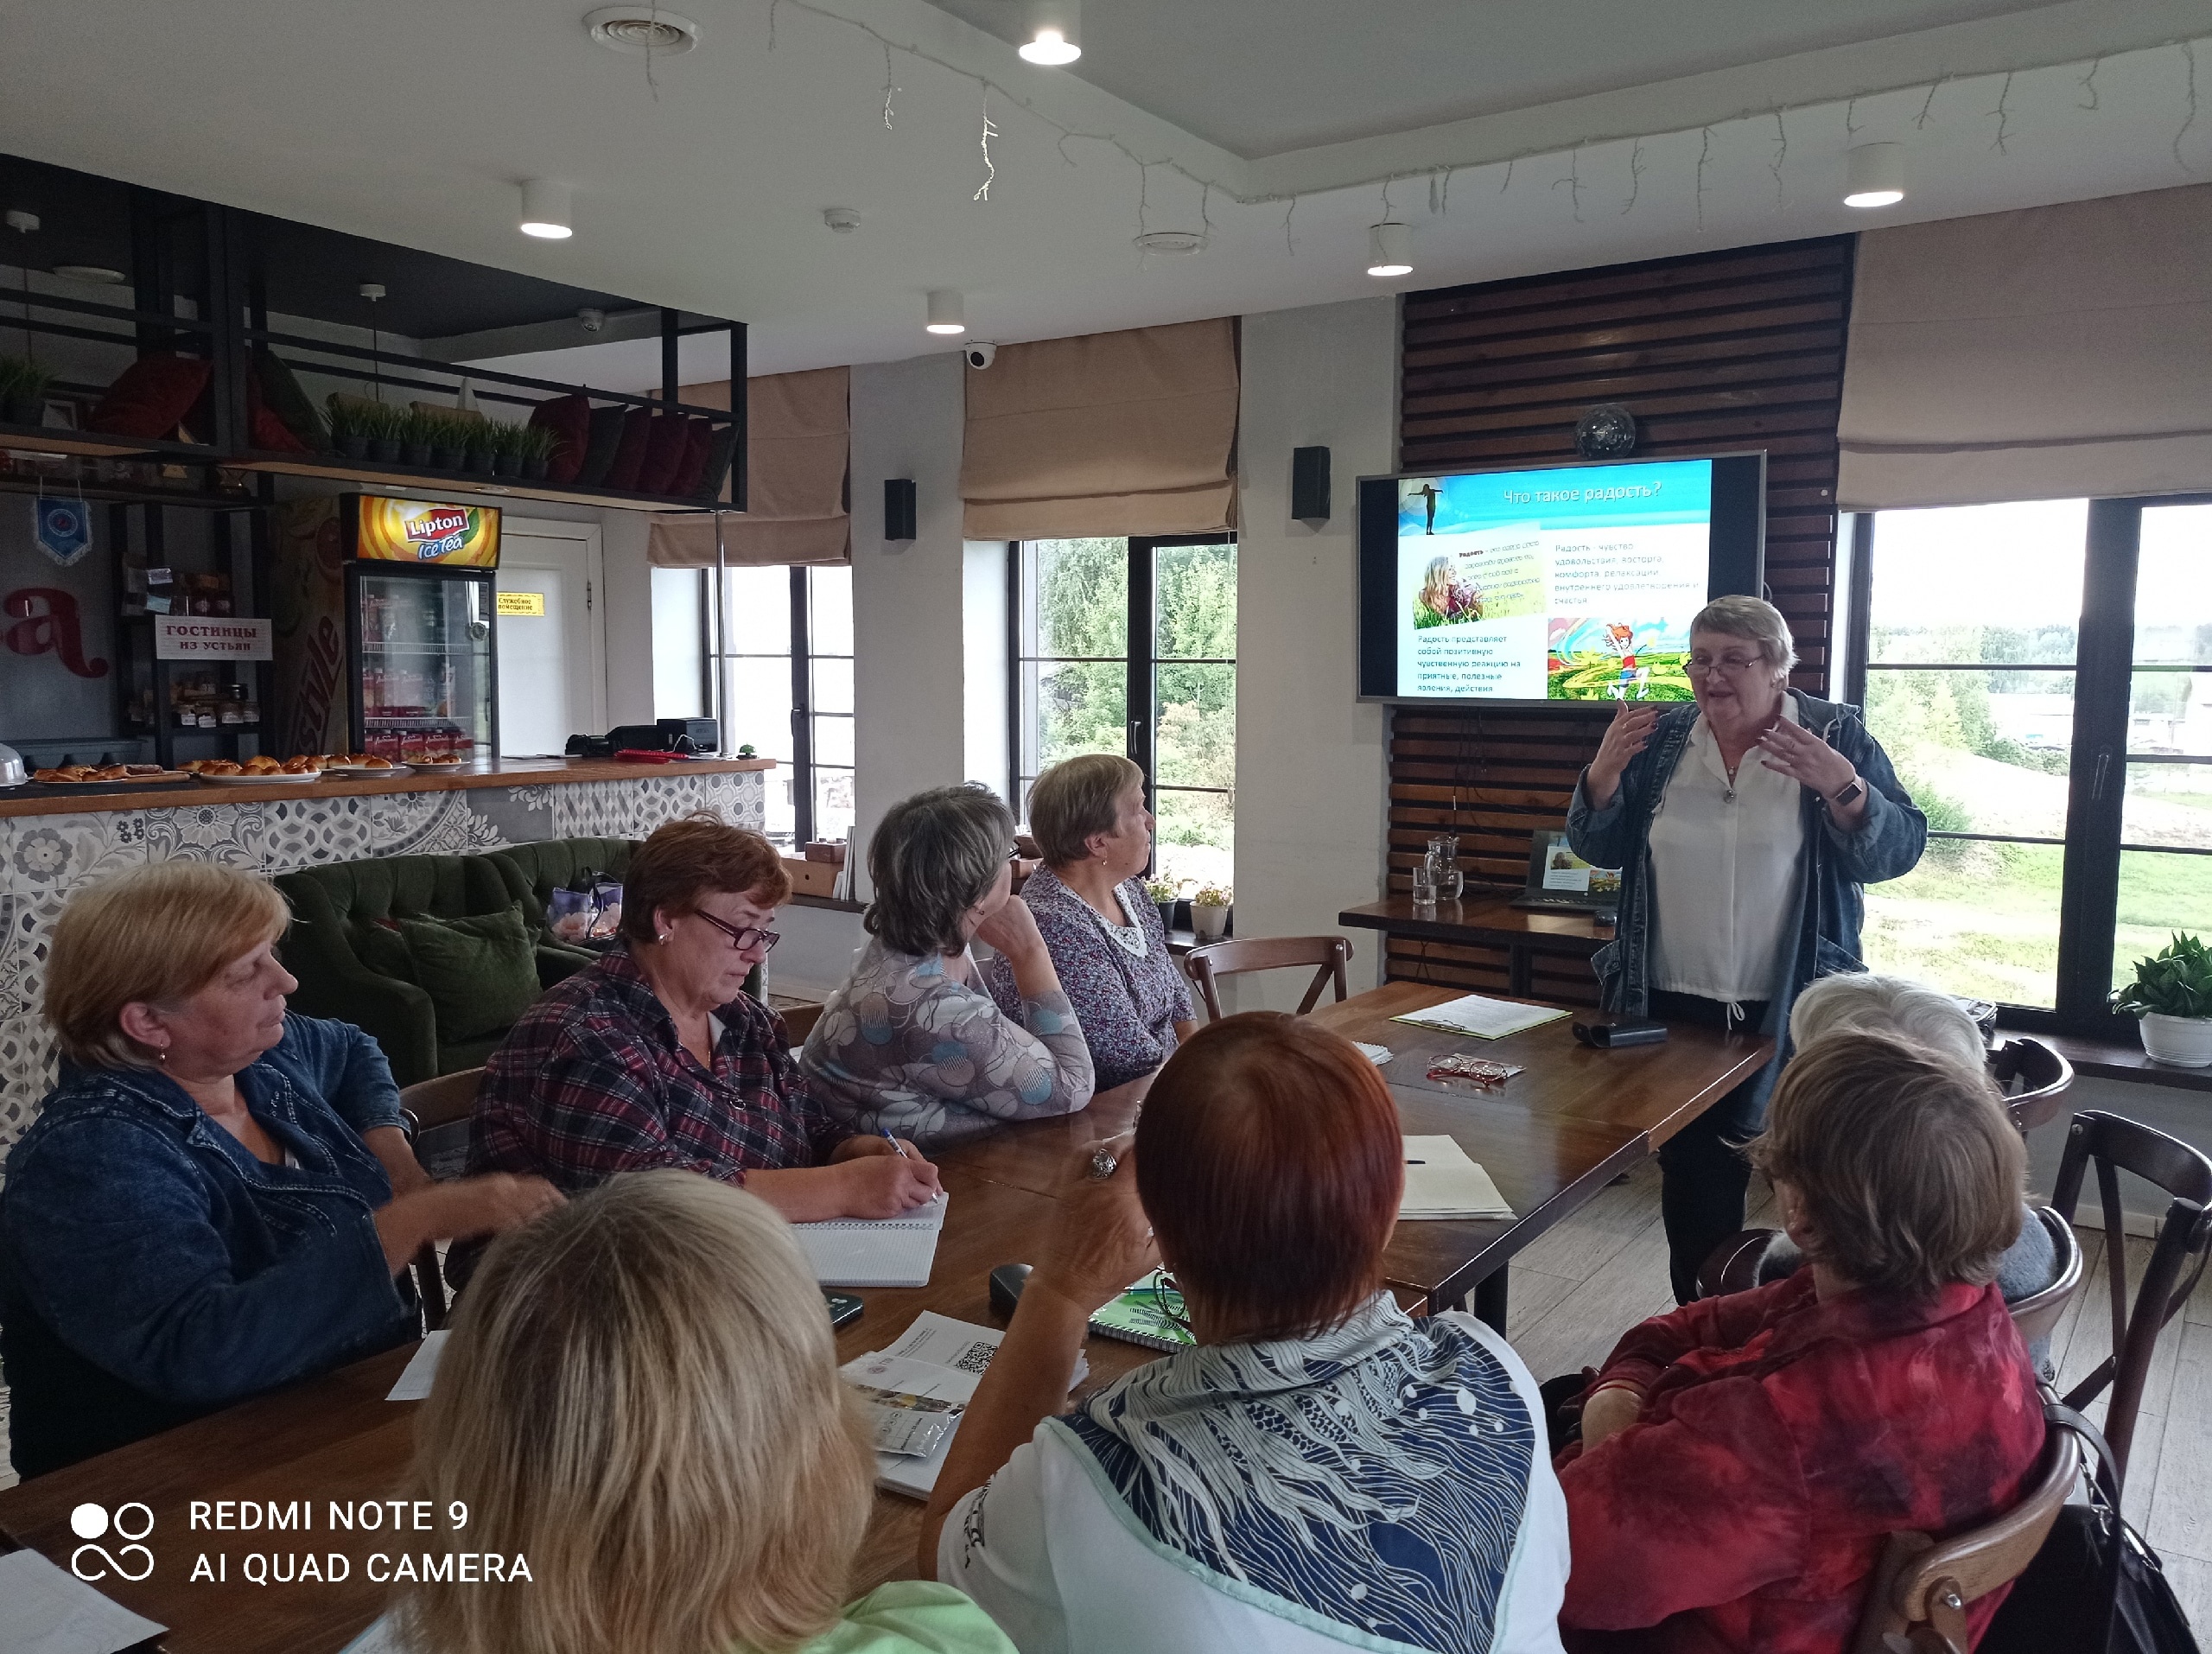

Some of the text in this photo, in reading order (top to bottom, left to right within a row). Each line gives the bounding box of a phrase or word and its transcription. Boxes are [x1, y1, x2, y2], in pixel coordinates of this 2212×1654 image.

[1503, 481, 1662, 504] Что такое радость?
[410, 515, 464, 537] Lipton
[417, 535, 464, 560] Ice Tea
[1599, 544, 1634, 552] чувство
[166, 625, 257, 639] ГОСТИНЦЫ
[180, 641, 251, 651] ИЗ УСТЬЯН
[1418, 635, 1450, 644] Радость
